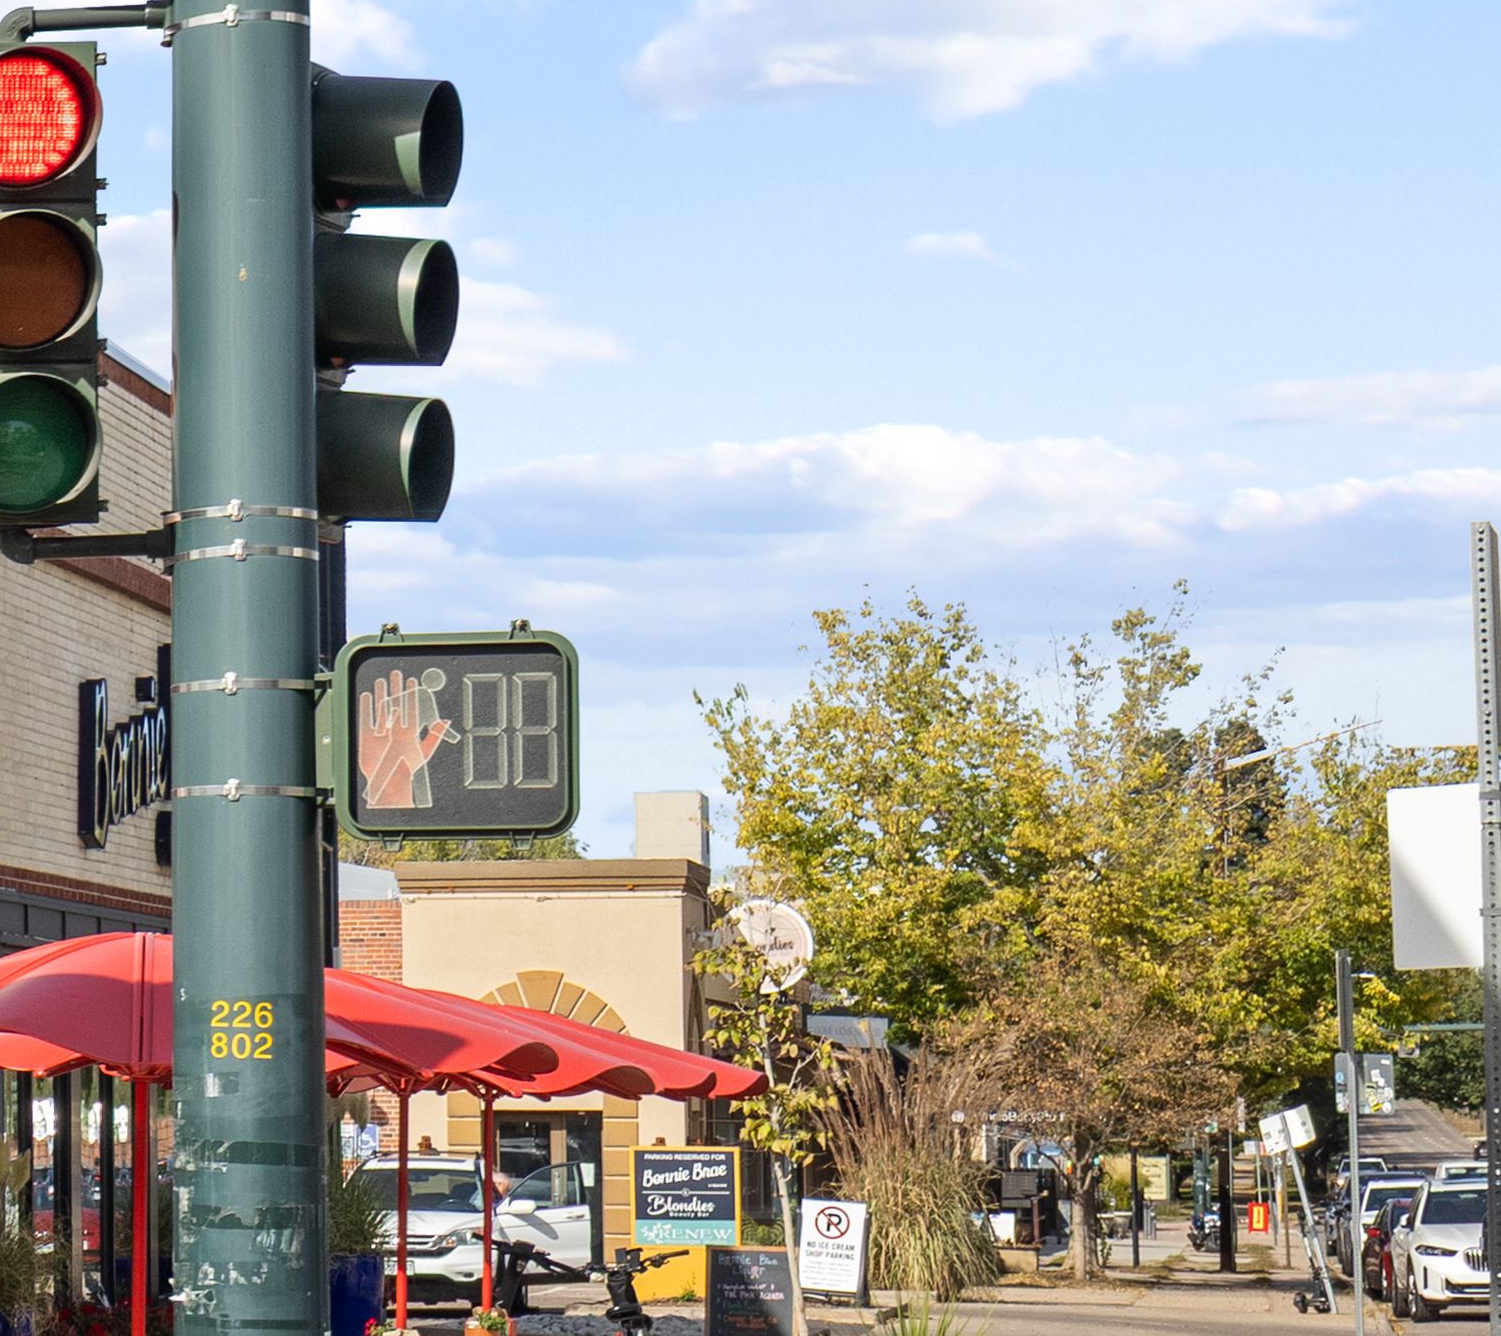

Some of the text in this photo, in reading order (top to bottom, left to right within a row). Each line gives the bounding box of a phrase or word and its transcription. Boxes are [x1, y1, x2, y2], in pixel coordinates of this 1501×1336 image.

[210, 1000, 274, 1029] 226
[210, 1032, 274, 1061] 802
[642, 1162, 728, 1188] Bonnie Brae
[646, 1194, 716, 1216] Blondies
[658, 1227, 733, 1240] RENEW
